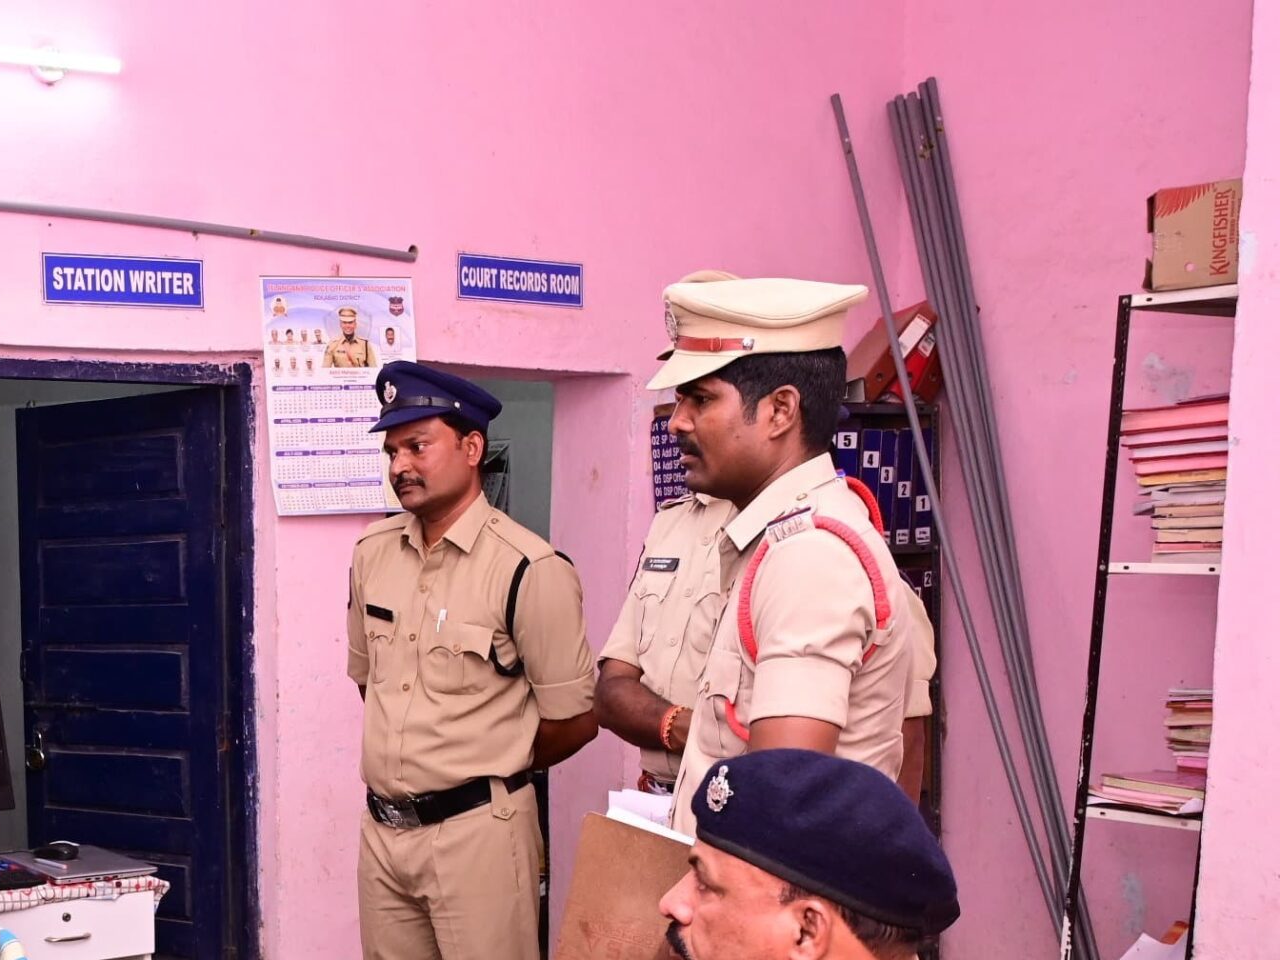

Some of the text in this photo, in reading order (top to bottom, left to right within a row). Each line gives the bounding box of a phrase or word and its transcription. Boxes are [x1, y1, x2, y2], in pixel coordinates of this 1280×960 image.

[1209, 188, 1233, 276] KINGFISHER
[52, 266, 195, 295] STATION WRITER
[461, 266, 580, 295] COURT RECORDS ROOM
[652, 436, 660, 445] 02
[843, 434, 852, 447] 5
[652, 449, 660, 458] 03
[867, 453, 874, 466] 4
[654, 462, 661, 471] 04
[673, 460, 680, 470] SP
[655, 474, 661, 484] 05
[663, 474, 673, 483] DSP
[884, 469, 890, 481] 3
[664, 487, 673, 496] DSP
[902, 484, 908, 496] 2
[920, 498, 926, 509] 1
[925, 573, 931, 585] 2
